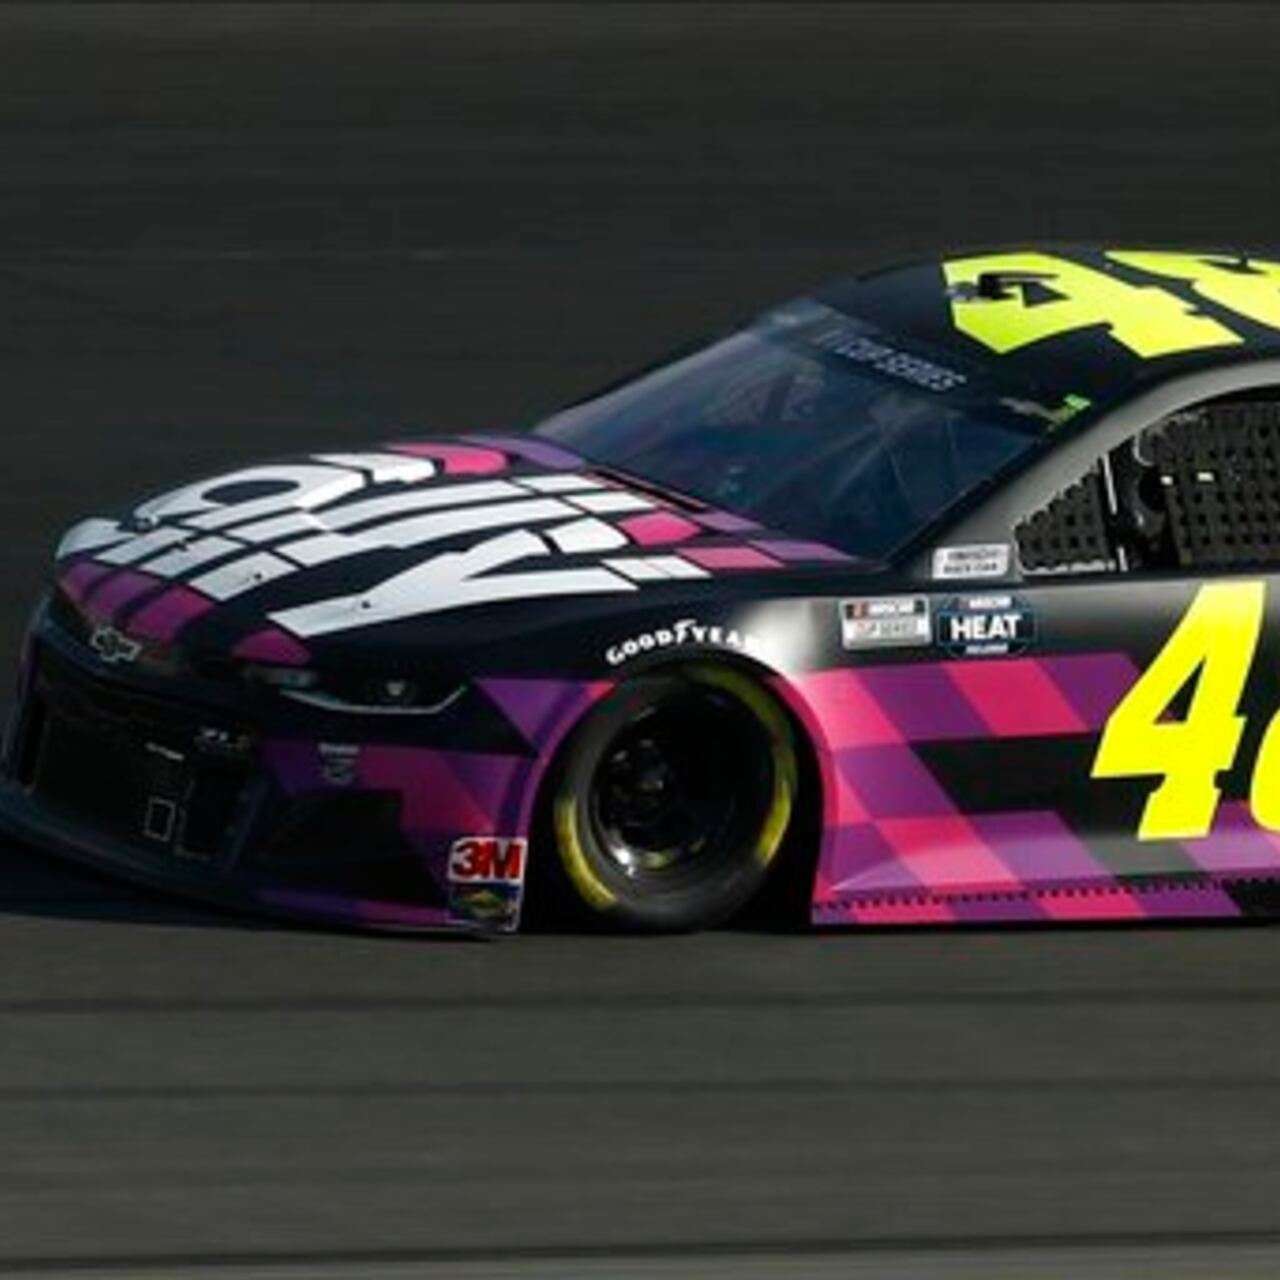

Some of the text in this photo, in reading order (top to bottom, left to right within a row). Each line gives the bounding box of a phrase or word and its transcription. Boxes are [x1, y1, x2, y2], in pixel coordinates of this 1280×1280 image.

[874, 353, 968, 393] SERIES
[949, 614, 1022, 640] HEAT
[451, 840, 523, 880] 3M
